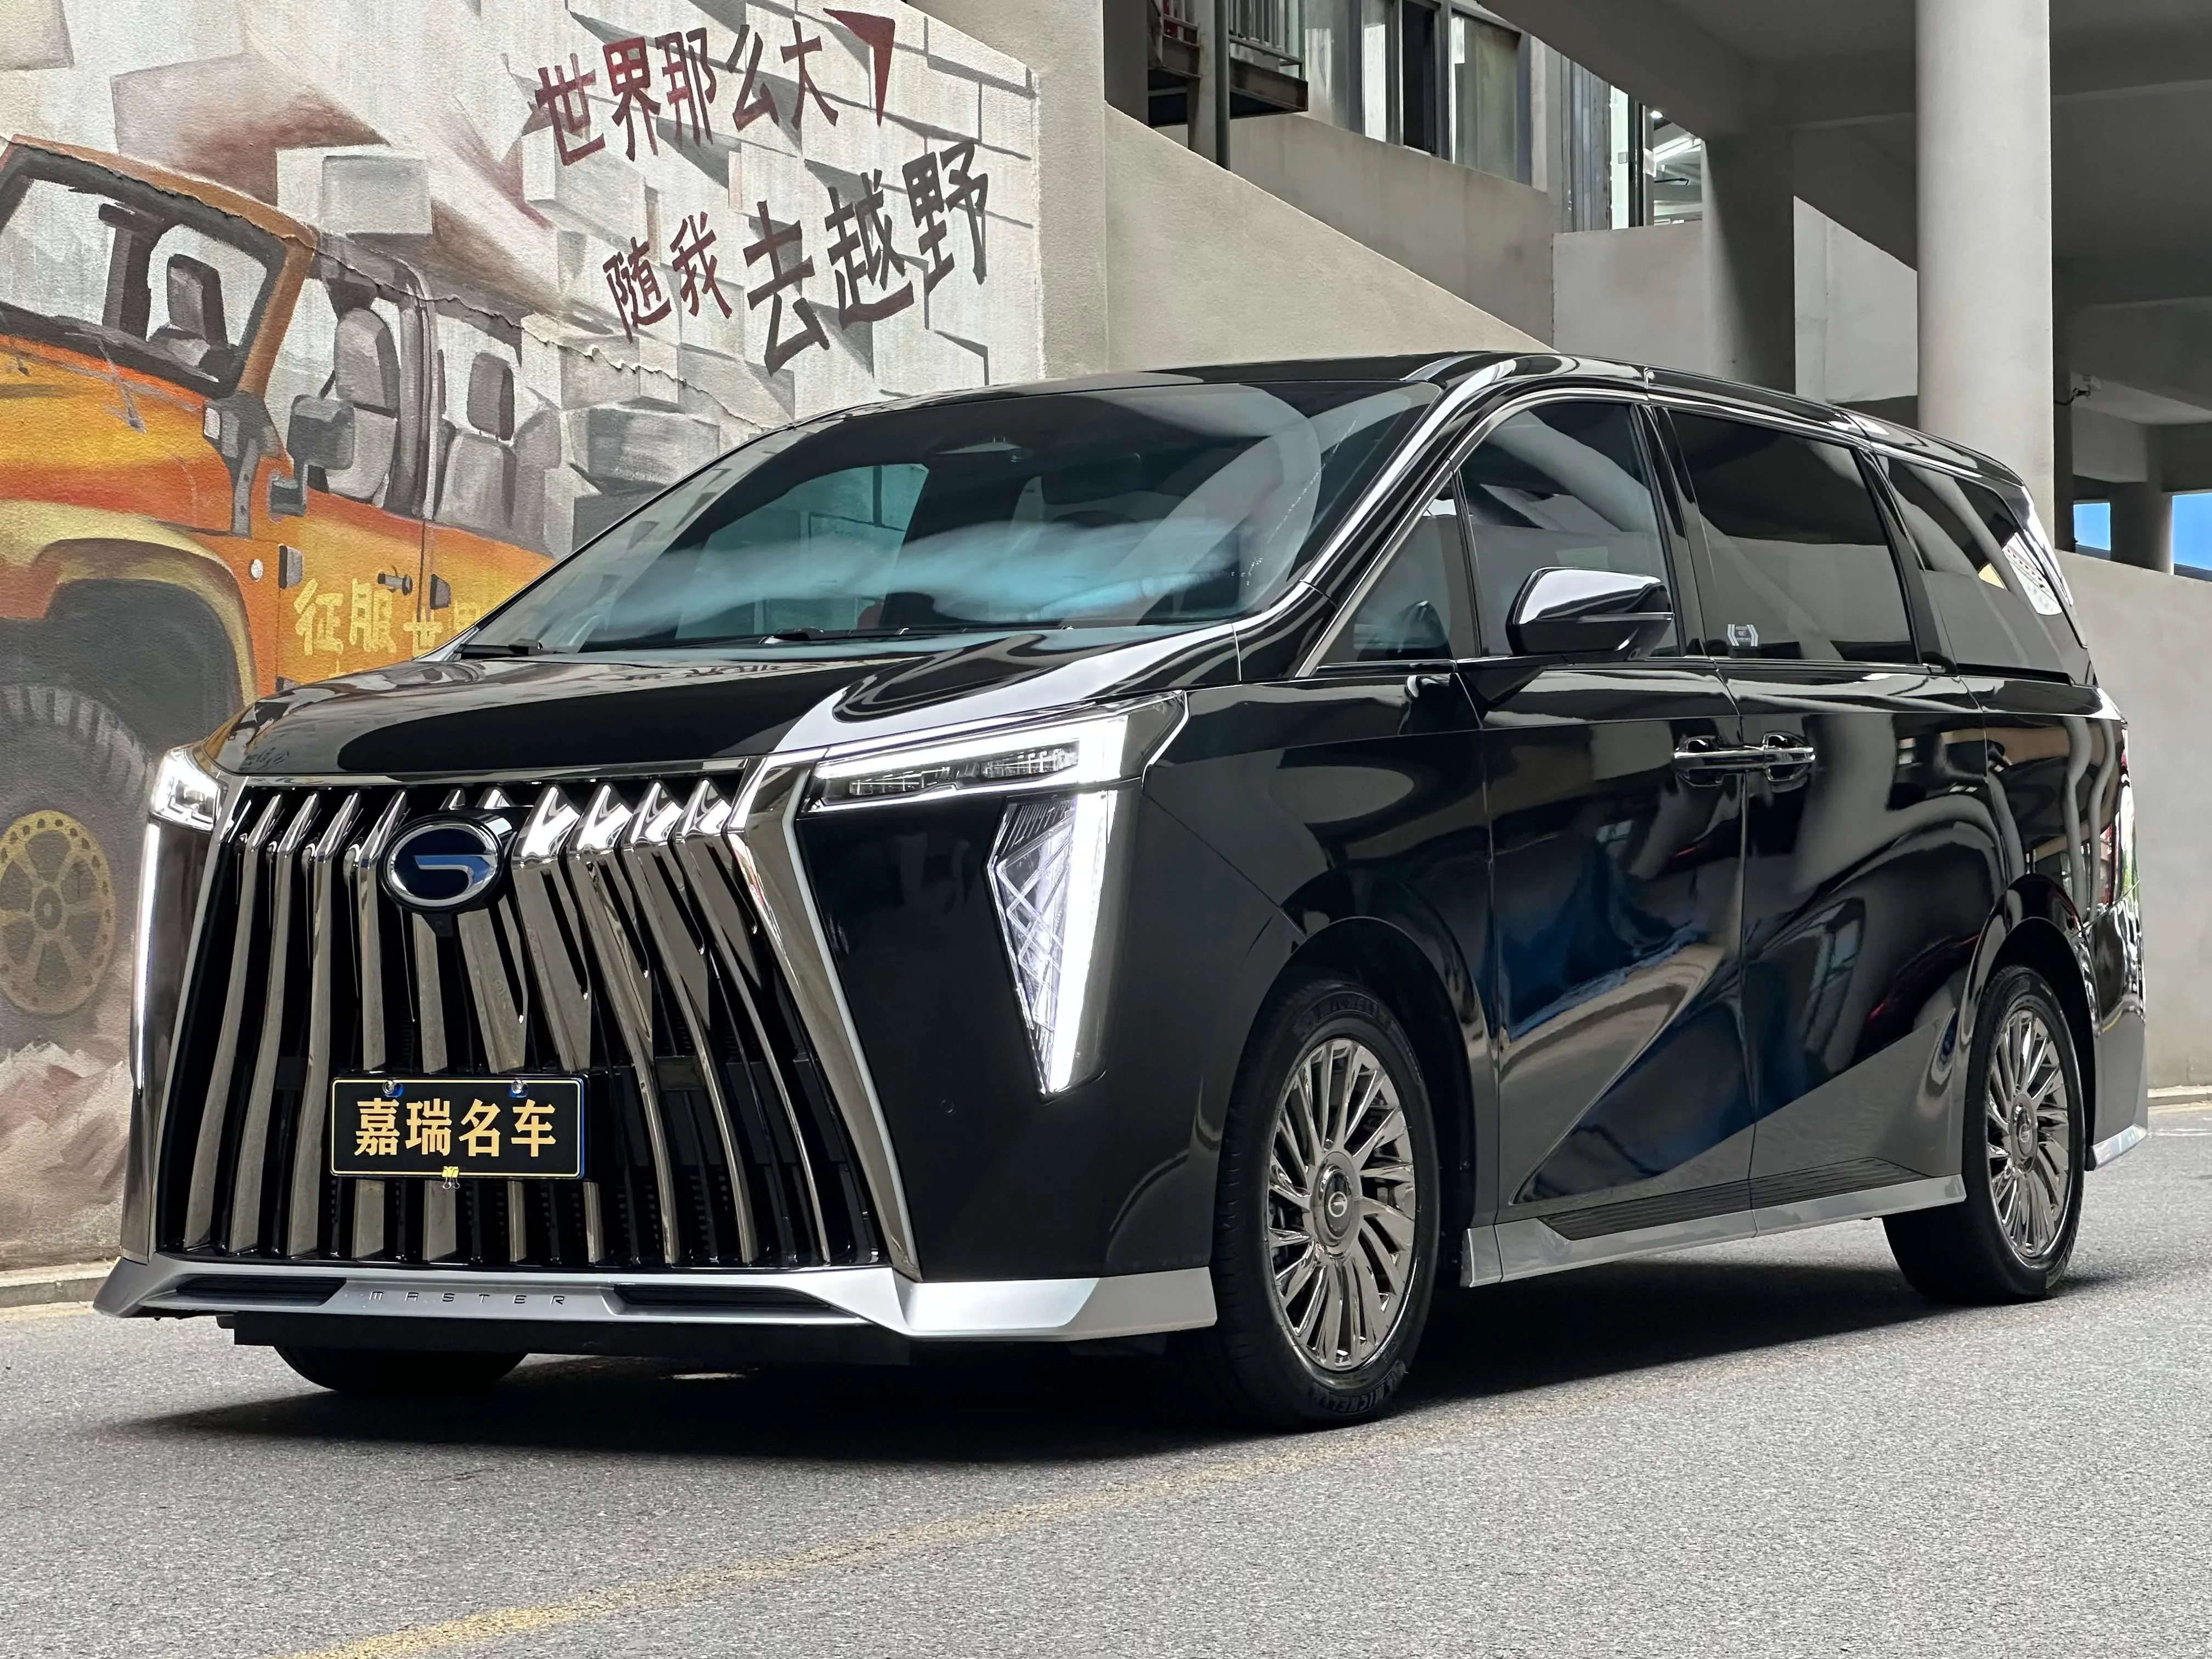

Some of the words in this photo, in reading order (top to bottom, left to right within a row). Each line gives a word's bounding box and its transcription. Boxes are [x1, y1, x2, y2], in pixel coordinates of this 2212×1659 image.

[534, 20, 839, 166] 世界那么大
[603, 143, 988, 376] 随我去越野
[354, 1098, 556, 1157] 嘉瑞名车
[369, 1291, 565, 1305] MASTER
